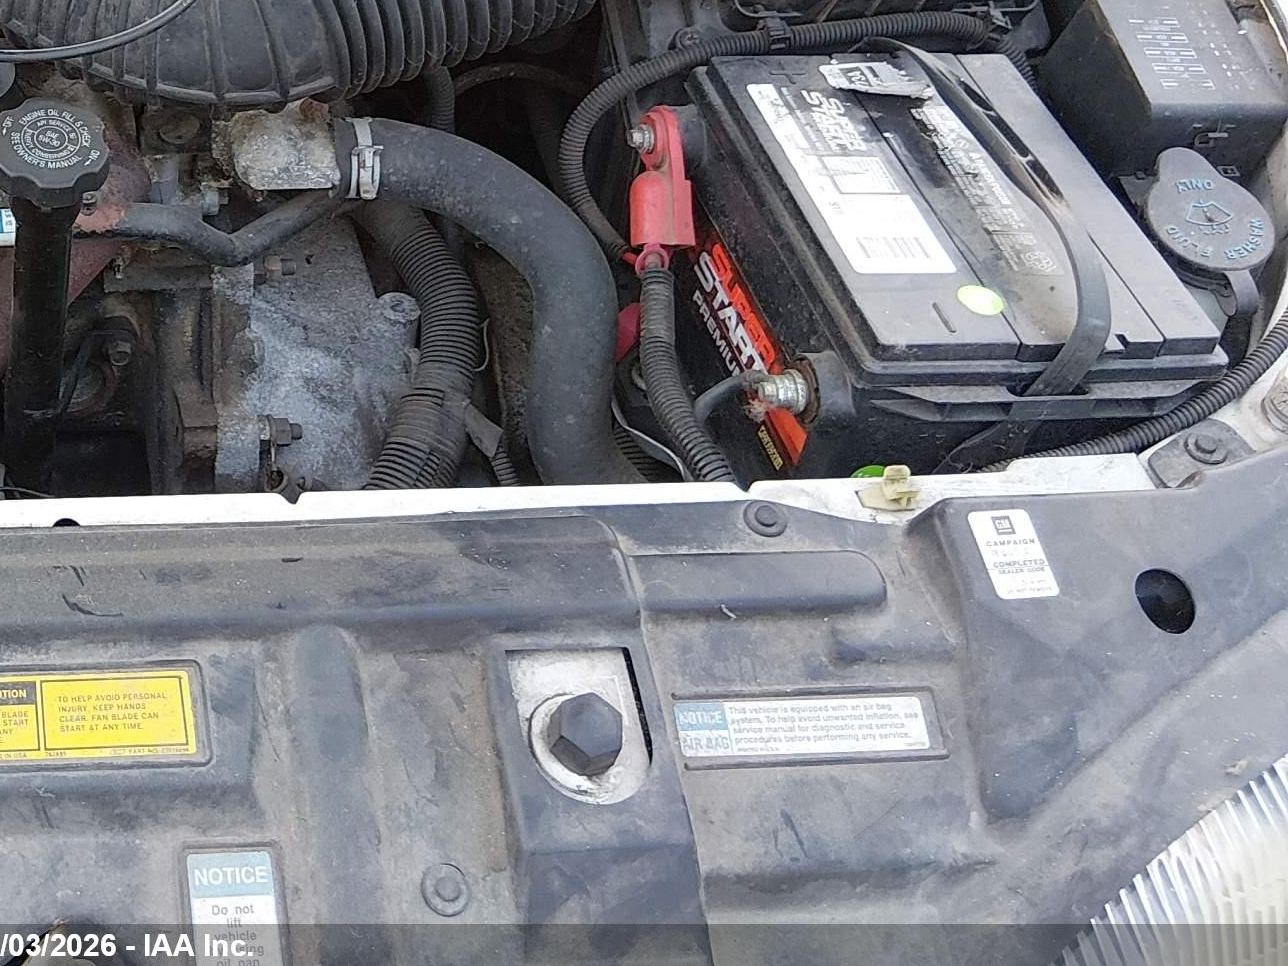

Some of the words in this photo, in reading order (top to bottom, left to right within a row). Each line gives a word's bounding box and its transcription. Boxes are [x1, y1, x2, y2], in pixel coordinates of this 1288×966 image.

[18, 110, 46, 126] ENGINE
[48, 108, 60, 116] OIL
[62, 111, 76, 122] FILL
[79, 124, 92, 148] CHECK
[48, 120, 72, 132] SERVICE
[828, 97, 868, 151] SUPER
[11, 132, 20, 144] SEE
[13, 144, 46, 168] OWNER'S
[47, 154, 83, 168] MANUAL
[1176, 178, 1214, 194] ONLY
[1166, 224, 1213, 258] FLUID
[1224, 218, 1264, 260] WASHER
[694, 250, 769, 376] START
[712, 241, 777, 372] SUPER
[986, 538, 1036, 547] CAMPAIGN
[993, 559, 1046, 568] COMPLETED
[71, 694, 92, 702] HELP
[95, 694, 120, 702] AVOID
[122, 692, 167, 700] PERSONAL
[2, 710, 28, 718] BLADE
[92, 704, 114, 712] KEEP
[729, 706, 746, 715] This
[748, 705, 778, 714] vehicle
[780, 704, 788, 713] is
[790, 704, 830, 714] equipped
[831, 703, 849, 712] with
[864, 702, 874, 710] air
[876, 702, 892, 712] bag
[4, 718, 29, 726] START
[92, 714, 110, 722] FAN
[112, 713, 140, 721] BLADE
[142, 712, 160, 720] CAN
[678, 710, 724, 726] NOTICE
[730, 716, 762, 726] system.
[778, 714, 796, 724] help
[798, 713, 820, 722] avoid
[822, 712, 864, 722] unwanted
[904, 712, 918, 720] see
[60, 724, 86, 732] START
[89, 724, 100, 732] AT
[102, 723, 120, 732] ANY
[732, 725, 763, 734] service
[765, 724, 796, 733] manual
[798, 724, 810, 732] for
[812, 722, 855, 733] diagnostic
[858, 722, 874, 731] and
[876, 722, 906, 730] service
[682, 735, 703, 751] AIR
[705, 734, 730, 750] BAG
[734, 736, 782, 746] procedures
[784, 734, 812, 743] before
[814, 733, 860, 744] performing
[862, 733, 878, 742] any
[879, 732, 912, 740] service.
[194, 866, 269, 886] NOTICE
[212, 905, 229, 916] Do
[235, 904, 255, 914] not
[226, 918, 242, 928] lift
[214, 930, 257, 942] vehicle
